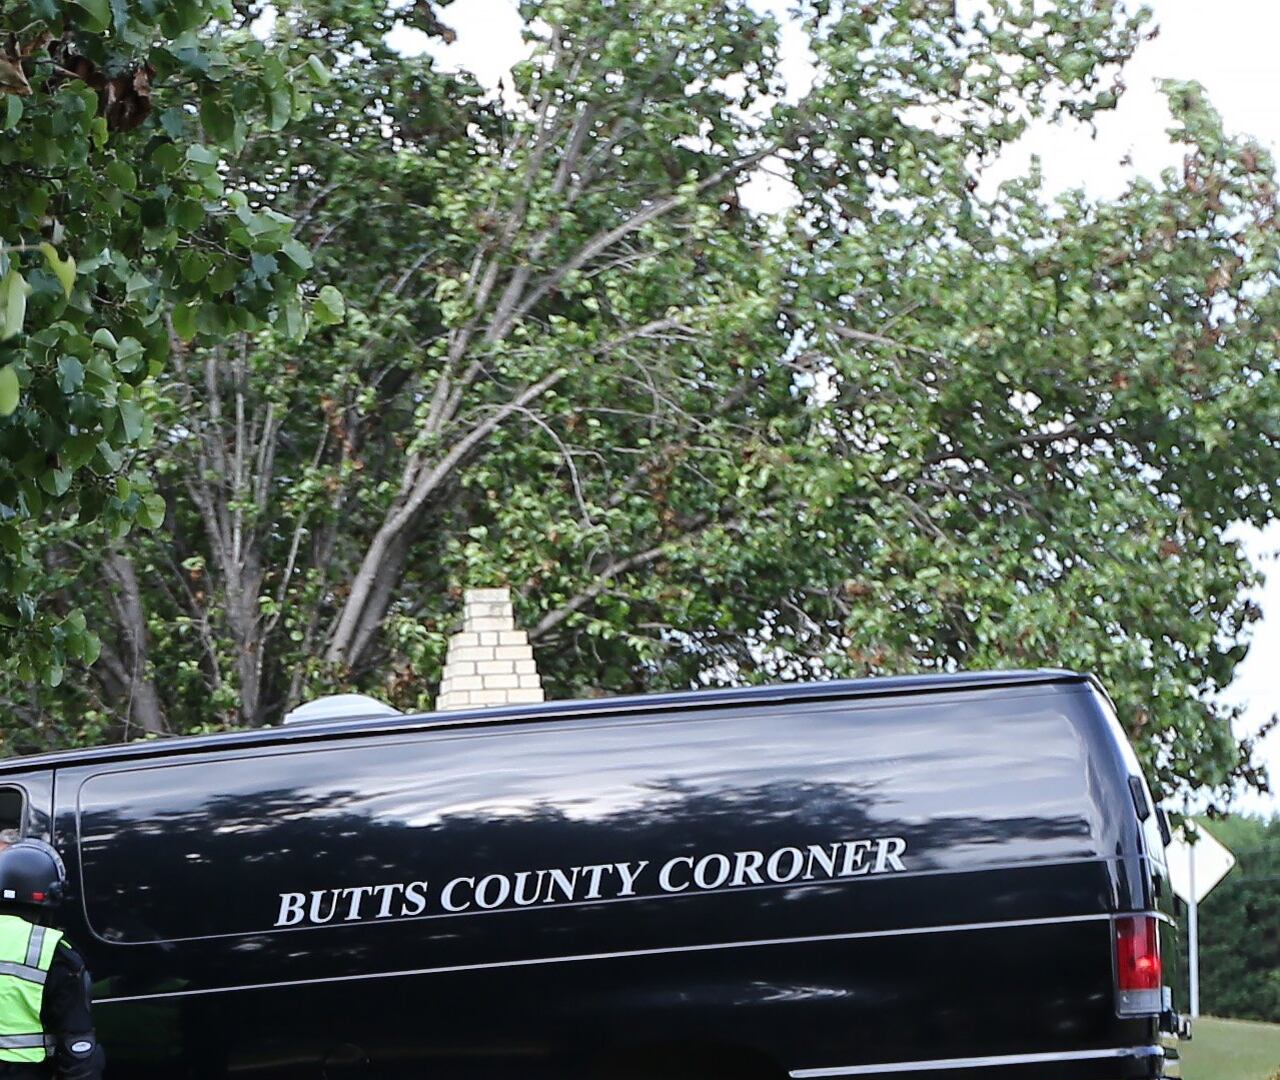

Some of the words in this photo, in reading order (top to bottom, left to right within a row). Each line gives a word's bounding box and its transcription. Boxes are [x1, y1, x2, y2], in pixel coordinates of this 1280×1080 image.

[274, 882, 428, 926] BUTTS
[441, 861, 647, 911] COUNTY
[658, 837, 907, 892] CORONER
